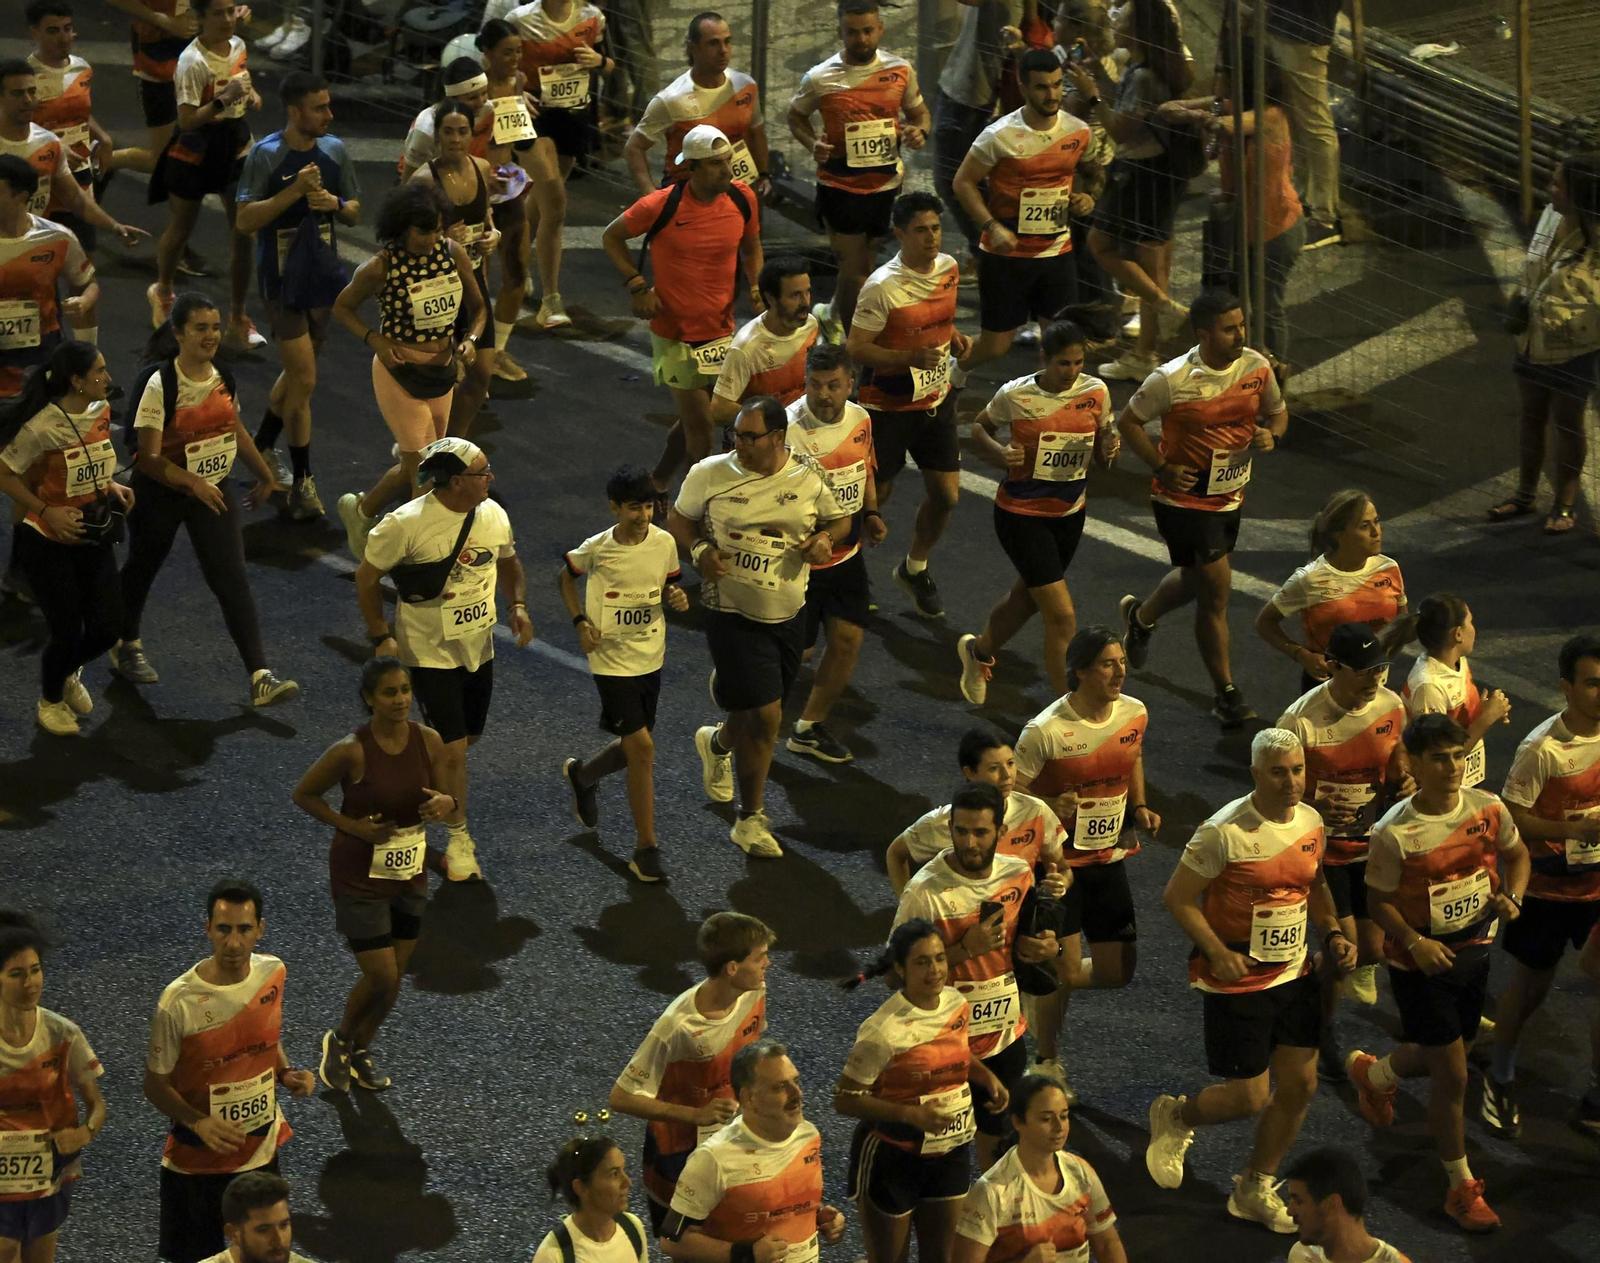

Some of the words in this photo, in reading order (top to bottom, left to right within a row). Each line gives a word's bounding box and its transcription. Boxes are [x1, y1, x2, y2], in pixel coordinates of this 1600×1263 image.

[551, 81, 580, 97] 8057
[497, 113, 528, 130] 17982
[852, 137, 891, 155] 11919
[1025, 205, 1063, 221] 22161
[423, 295, 456, 316] 6304
[919, 362, 947, 387] 13259
[197, 455, 227, 475] 4582
[1042, 451, 1085, 468] 20041
[77, 461, 105, 482] 8001
[734, 551, 769, 573] 1001
[453, 601, 488, 625] 2602
[614, 609, 651, 625] 1005
[1087, 815, 1121, 836] 8641
[385, 846, 418, 867] 8887
[1443, 893, 1479, 920] 9575
[1260, 924, 1302, 946] 15481
[972, 997, 1011, 1020] 6477
[219, 1094, 268, 1121] 16568
[0, 1155, 43, 1176] 6572
